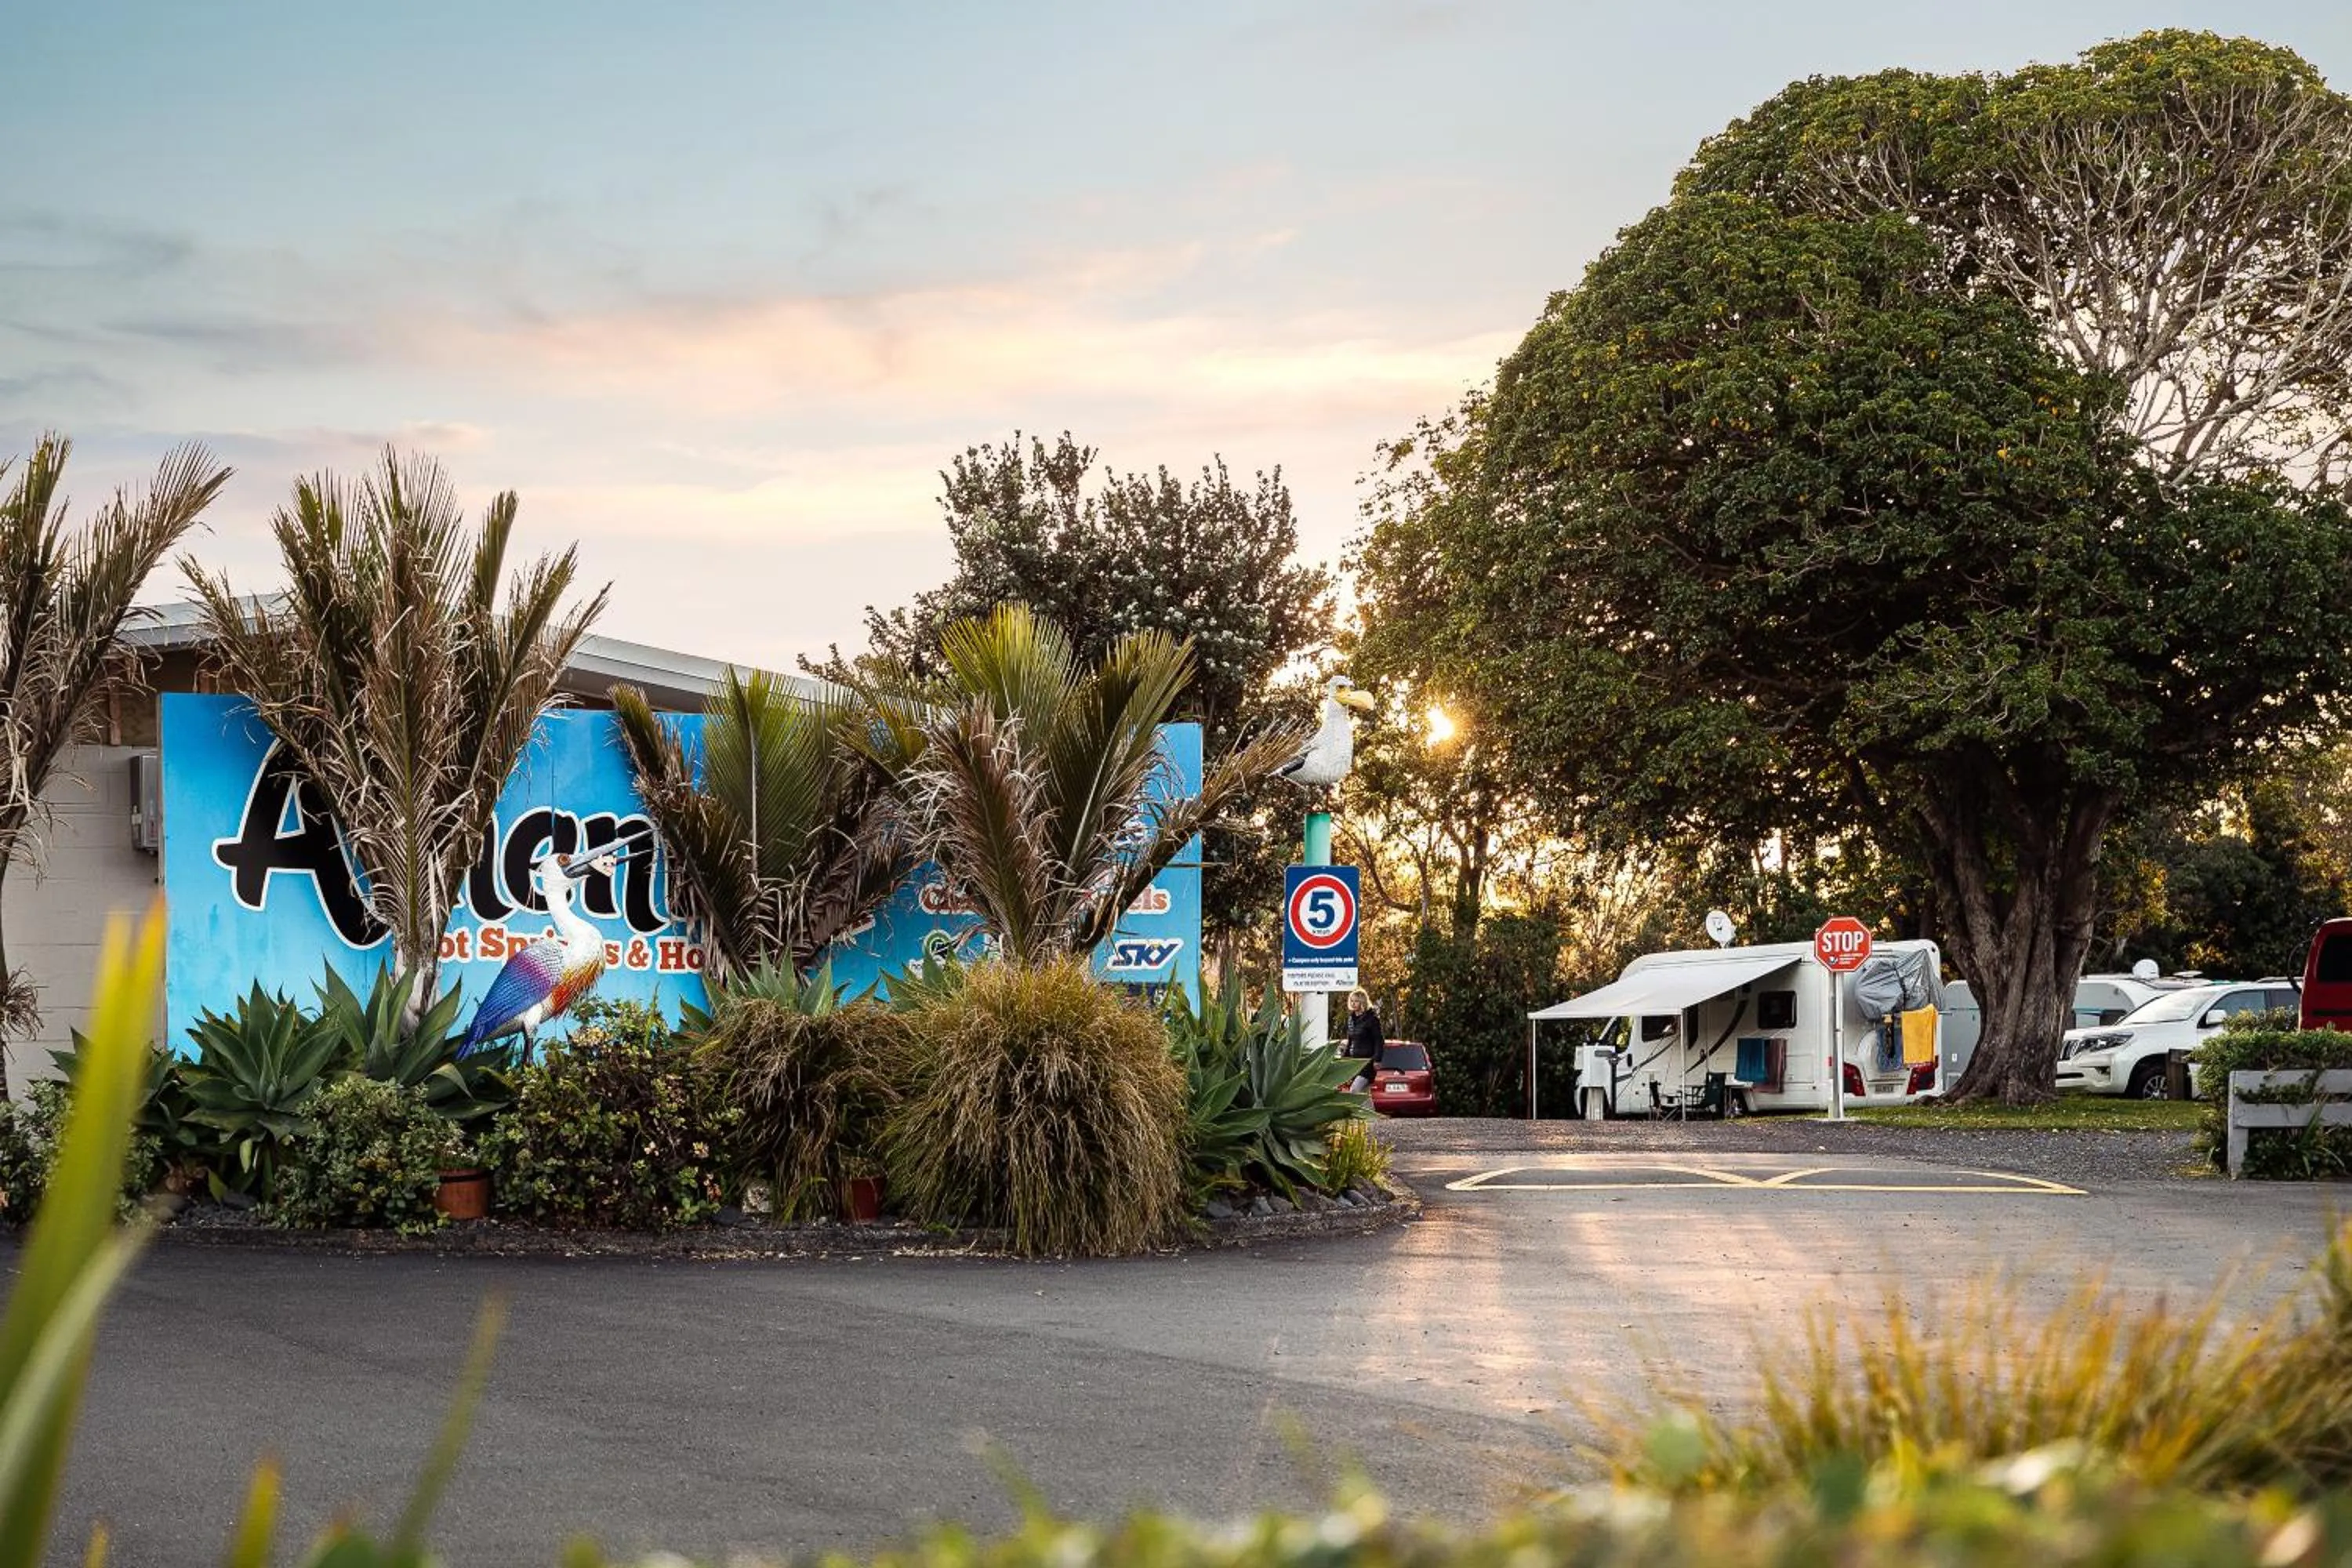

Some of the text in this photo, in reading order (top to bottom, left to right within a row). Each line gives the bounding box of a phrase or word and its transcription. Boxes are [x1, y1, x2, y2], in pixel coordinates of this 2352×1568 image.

[1307, 891, 1335, 928] 5
[627, 939, 649, 967] &
[1822, 931, 1864, 953] STOP
